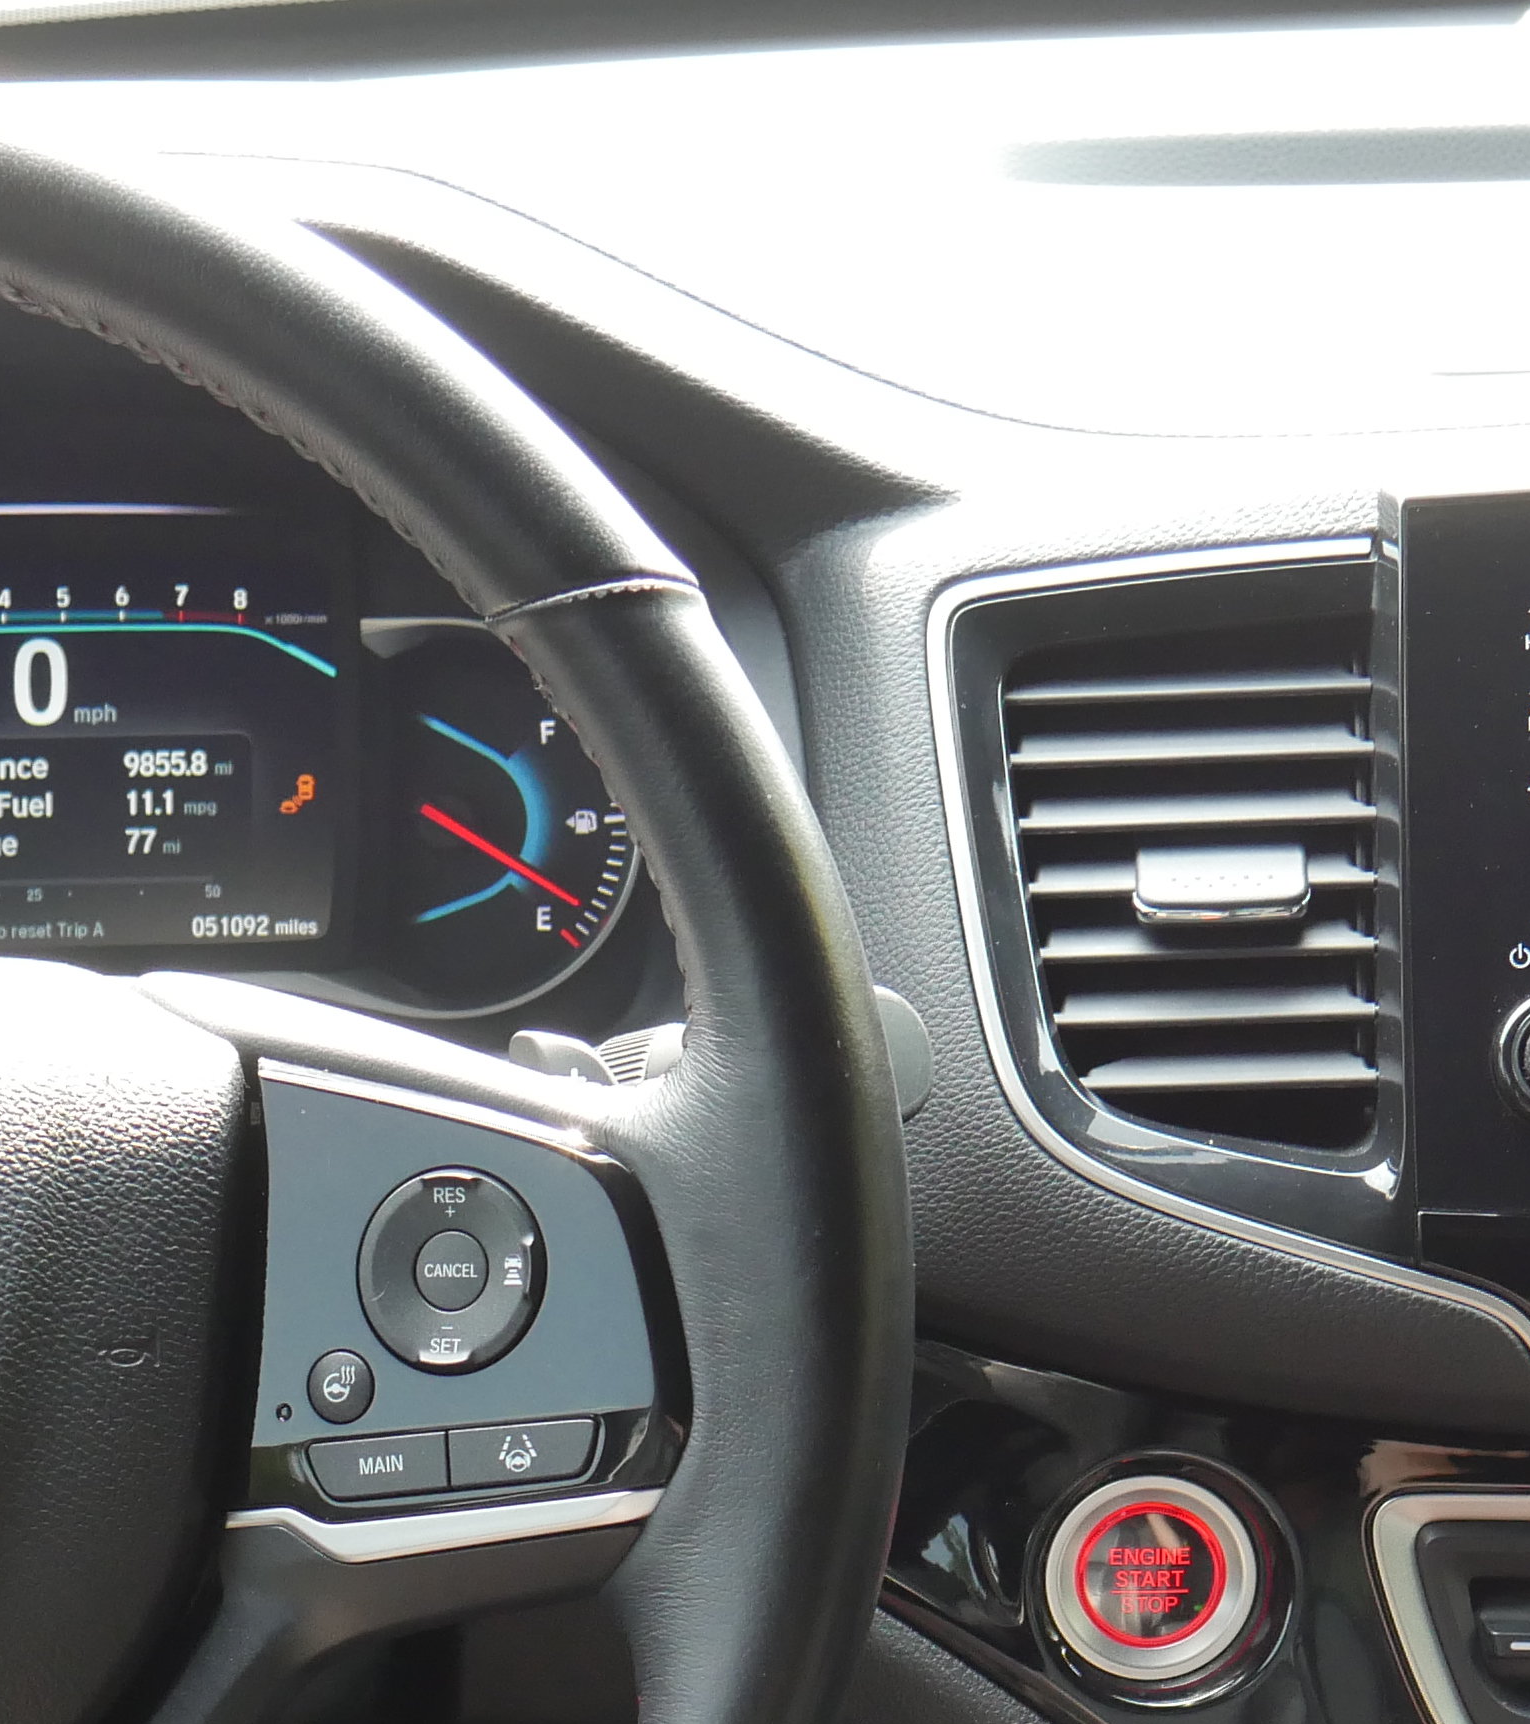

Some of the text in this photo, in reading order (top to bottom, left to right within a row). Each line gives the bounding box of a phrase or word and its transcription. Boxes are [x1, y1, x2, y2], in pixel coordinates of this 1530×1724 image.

[55, 586, 71, 608] 5
[114, 585, 130, 606] 6
[173, 584, 189, 605] 7
[232, 588, 247, 608] 8
[14, 639, 117, 725] 0 mph
[540, 720, 555, 744] F
[123, 751, 208, 777] 9855.8
[214, 760, 234, 775] mi
[126, 790, 174, 816] 11.1
[184, 801, 218, 819] mpg
[125, 829, 156, 855] 77
[163, 838, 181, 854] mi
[26, 889, 42, 901] 25
[205, 885, 221, 898] 50
[192, 915, 318, 938] 051092 miles
[537, 906, 552, 930] E
[11, 924, 51, 940] reset
[56, 922, 86, 942] Trip
[92, 922, 104, 938] A
[434, 1188, 465, 1202] RES
[425, 1263, 477, 1278] CANCEL
[430, 1339, 461, 1354] SET
[359, 1455, 403, 1474] MAIN
[1109, 1548, 1190, 1565] ENGINE
[1116, 1571, 1184, 1587] START
[1122, 1597, 1178, 1613] STOP
